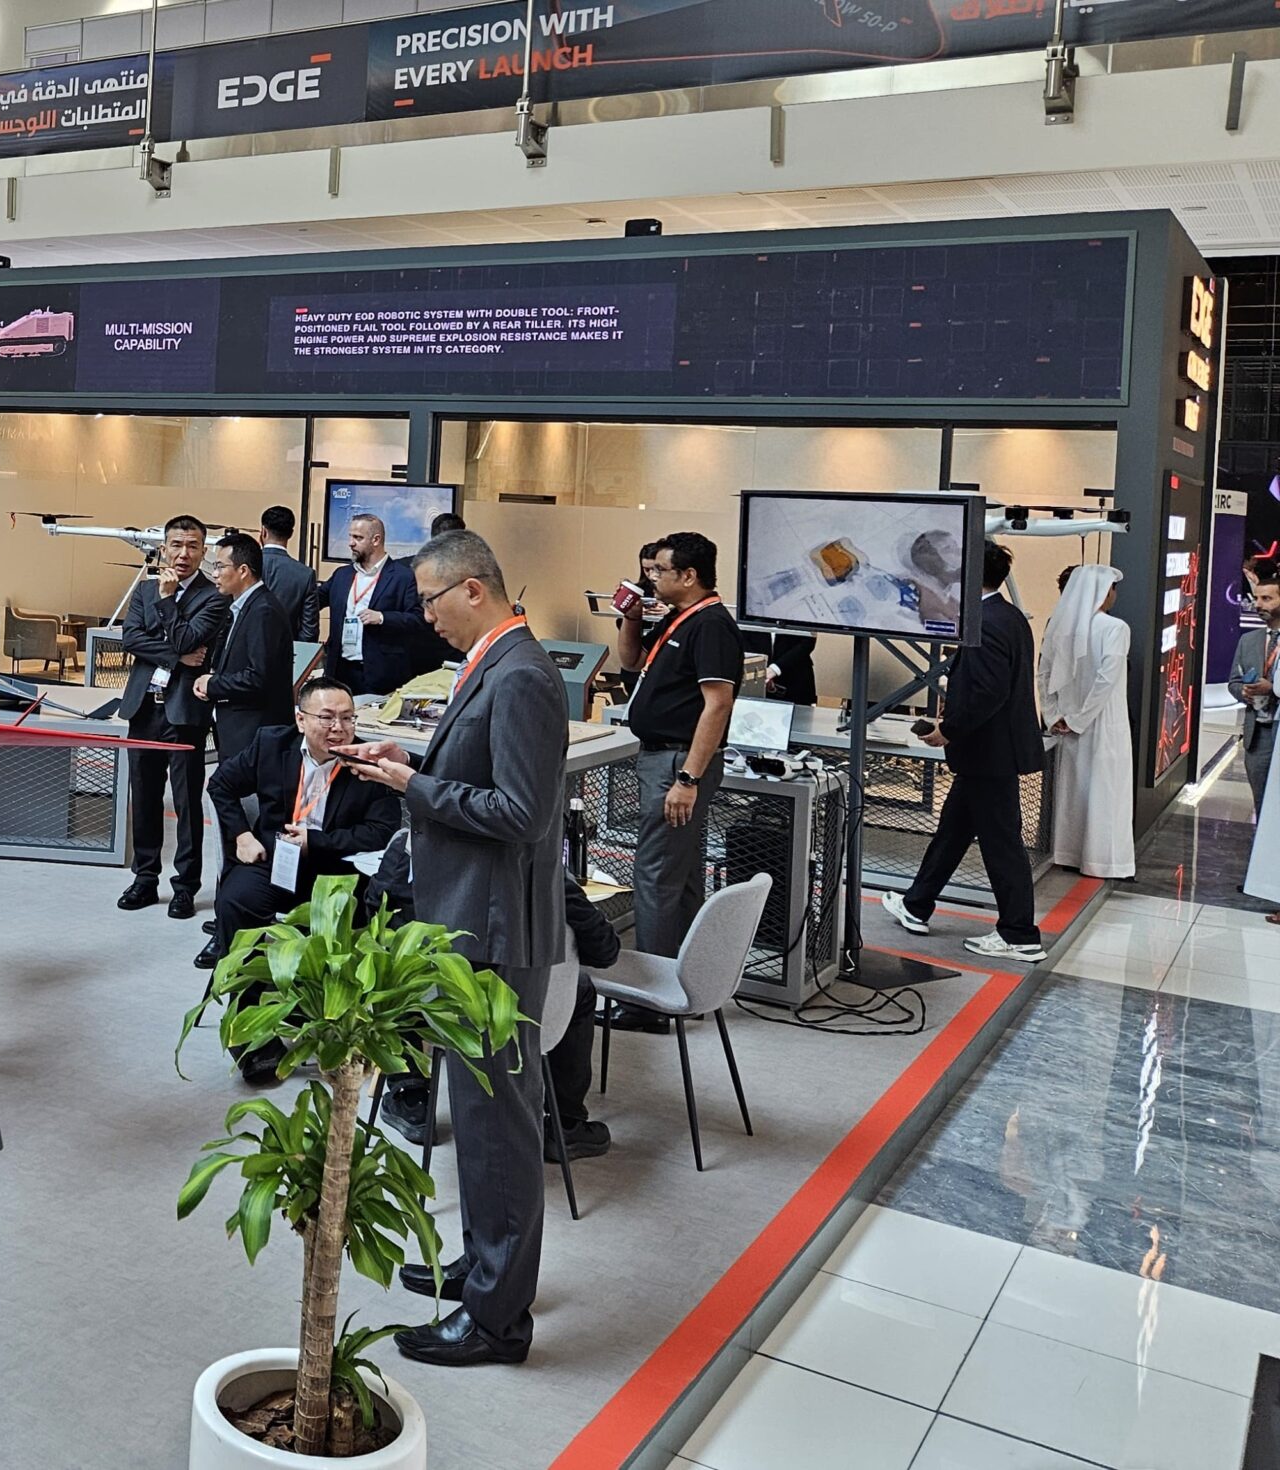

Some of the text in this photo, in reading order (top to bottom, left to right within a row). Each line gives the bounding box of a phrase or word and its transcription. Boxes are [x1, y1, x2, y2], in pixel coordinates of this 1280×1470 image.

[396, 5, 614, 56] PRECISION WITH
[394, 44, 593, 90] EVERY LAUNCH
[31, 77, 79, 101] الدقة
[84, 70, 148, 94] منتهى
[216, 67, 322, 109] EDGE
[0, 84, 28, 110] في
[61, 99, 146, 130] المتطلبات
[295, 306, 620, 322] HEAVY DUTY EOD ROBOTIC SYSTEM WITH DOUBLE TOOL: FRONT-
[105, 322, 193, 336] MULTI-MISSION
[295, 318, 618, 333] POSITIONED FLAIL TOOL FOLLOWED BY A REAR TILLER. ITS HIGH
[114, 338, 182, 351] CAPABILITY
[294, 330, 624, 345] ENGINE POWER AND SUPREME EXPLOSION RESISTANCE MAKES IT
[294, 344, 505, 355] THE STRONGEST SYSTEM IN ITS CATEGORY.
[1214, 494, 1232, 509] IRC
